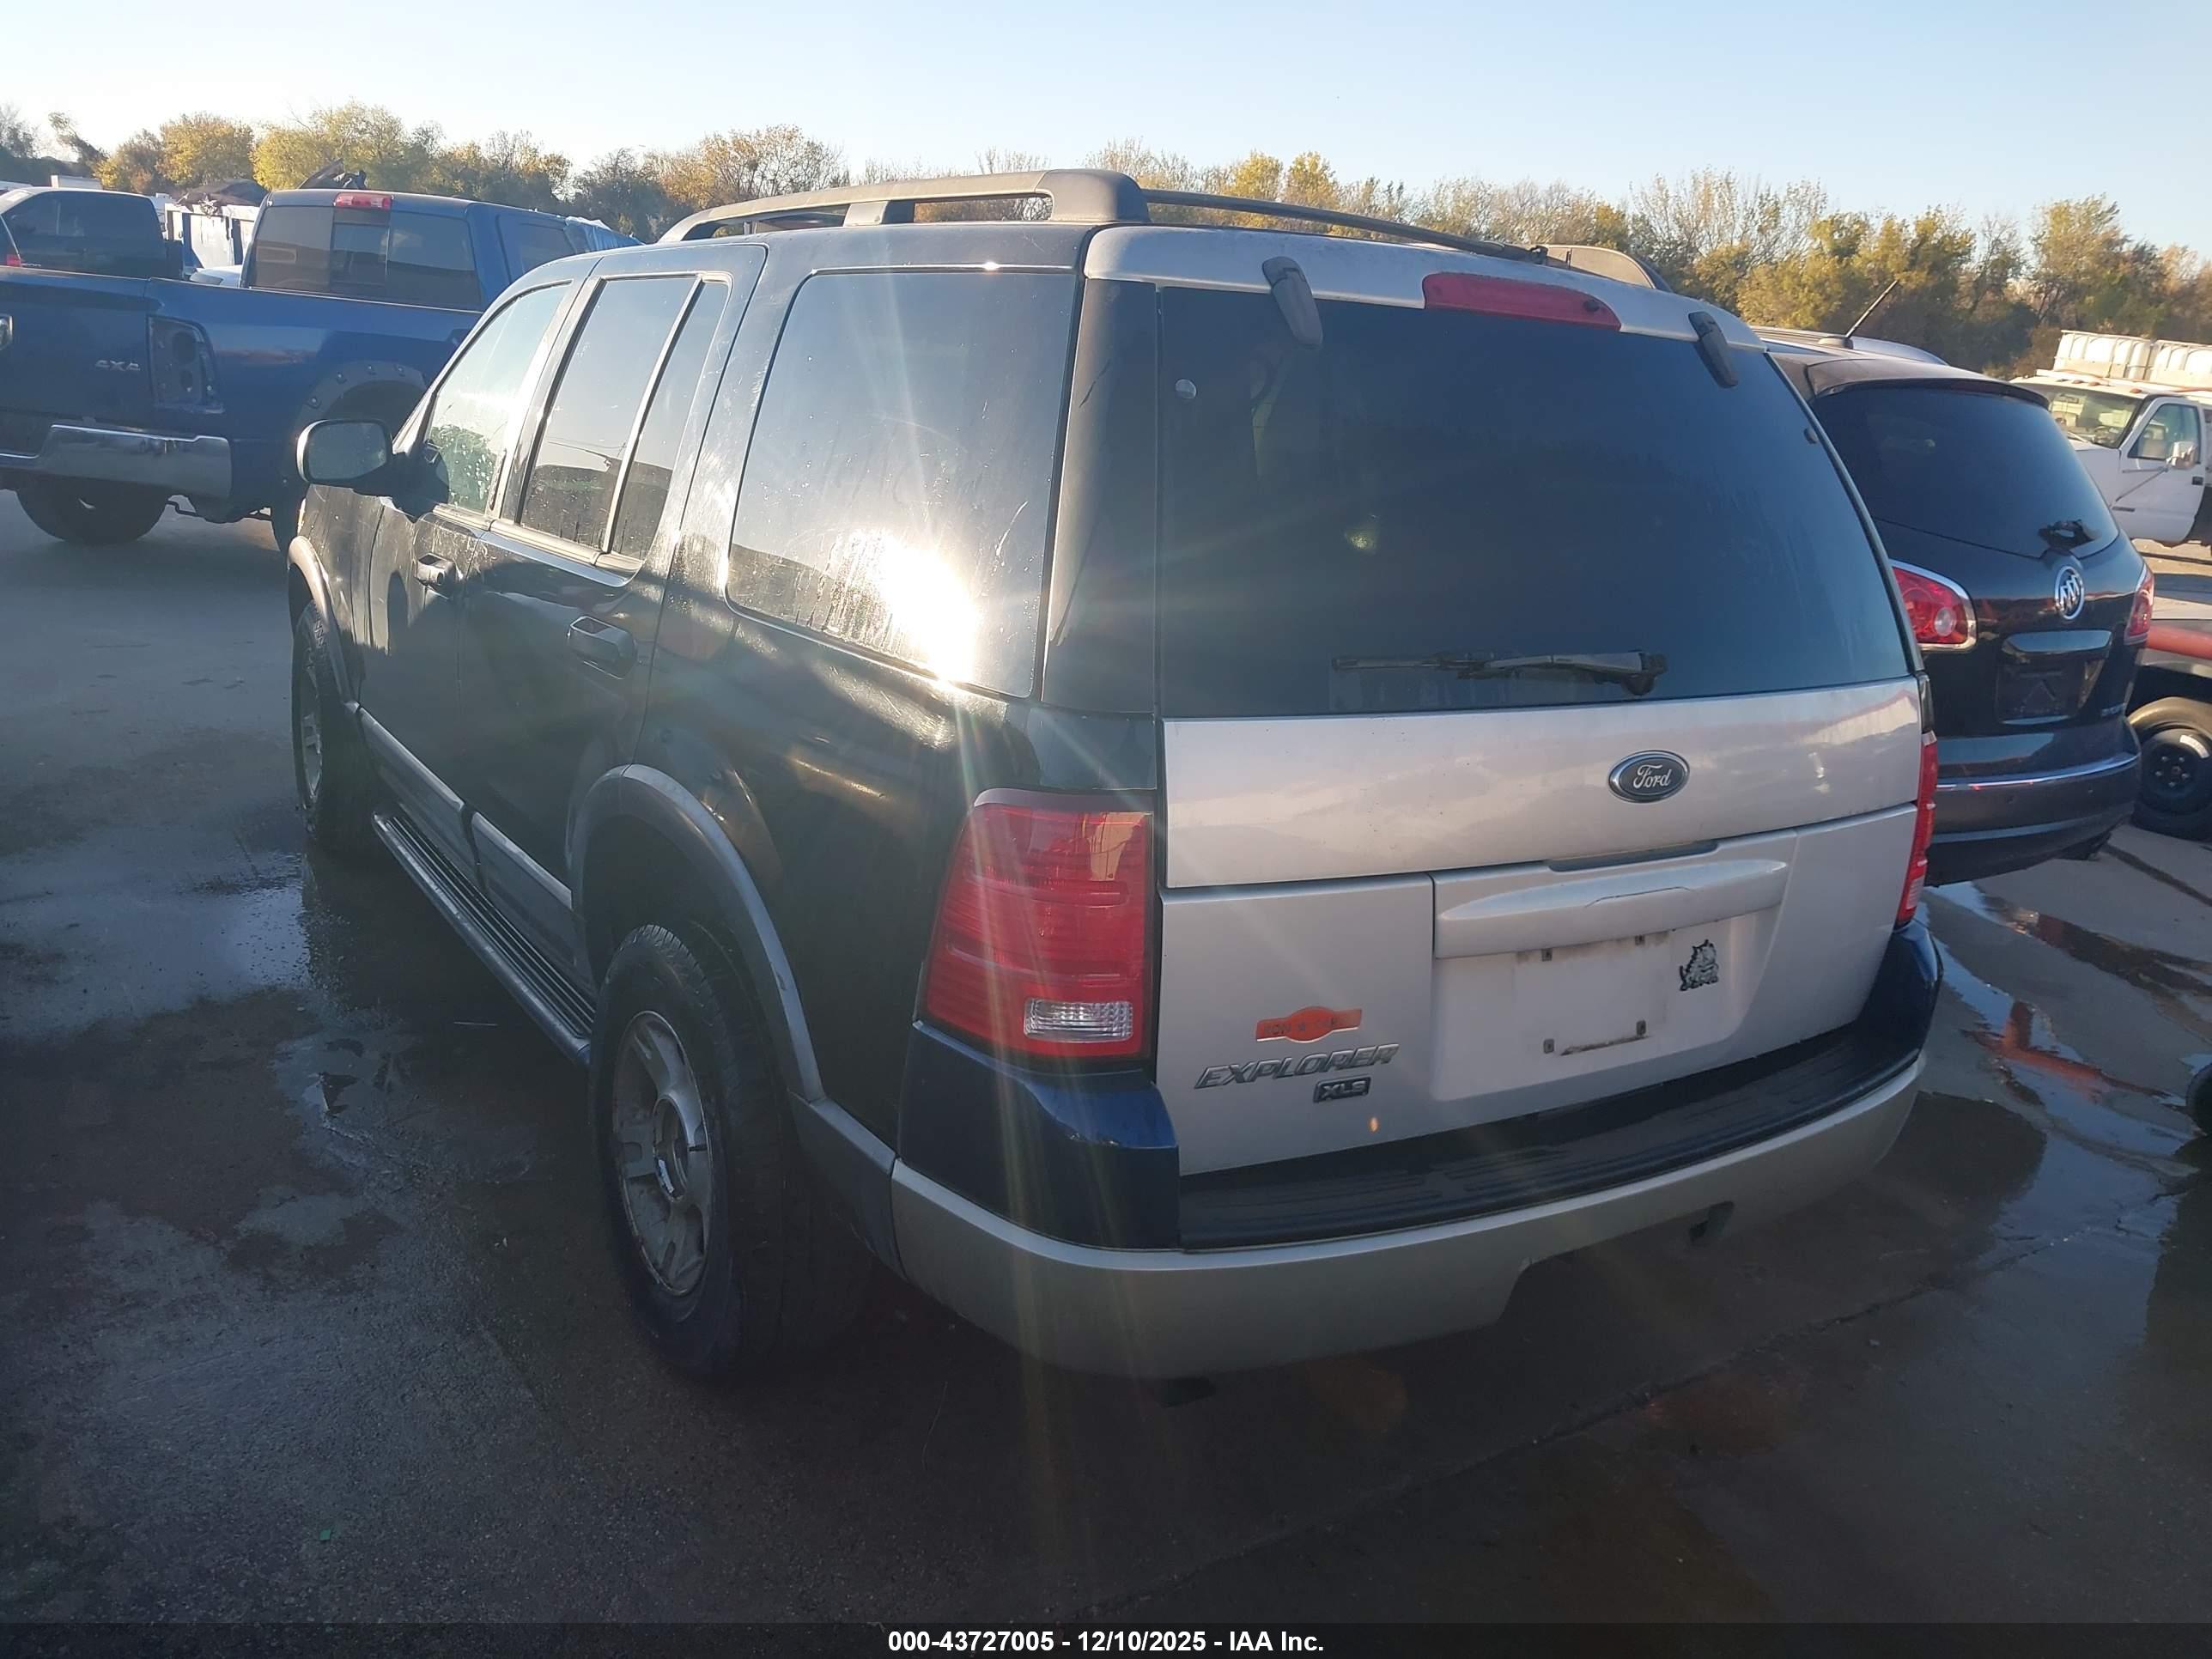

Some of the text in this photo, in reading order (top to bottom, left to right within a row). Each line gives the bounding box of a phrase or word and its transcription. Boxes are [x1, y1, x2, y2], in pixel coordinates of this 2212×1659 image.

[1632, 764, 1673, 789] Ford
[1194, 1043, 1400, 1089] EXPLORER
[1321, 1079, 1367, 1100] XLS
